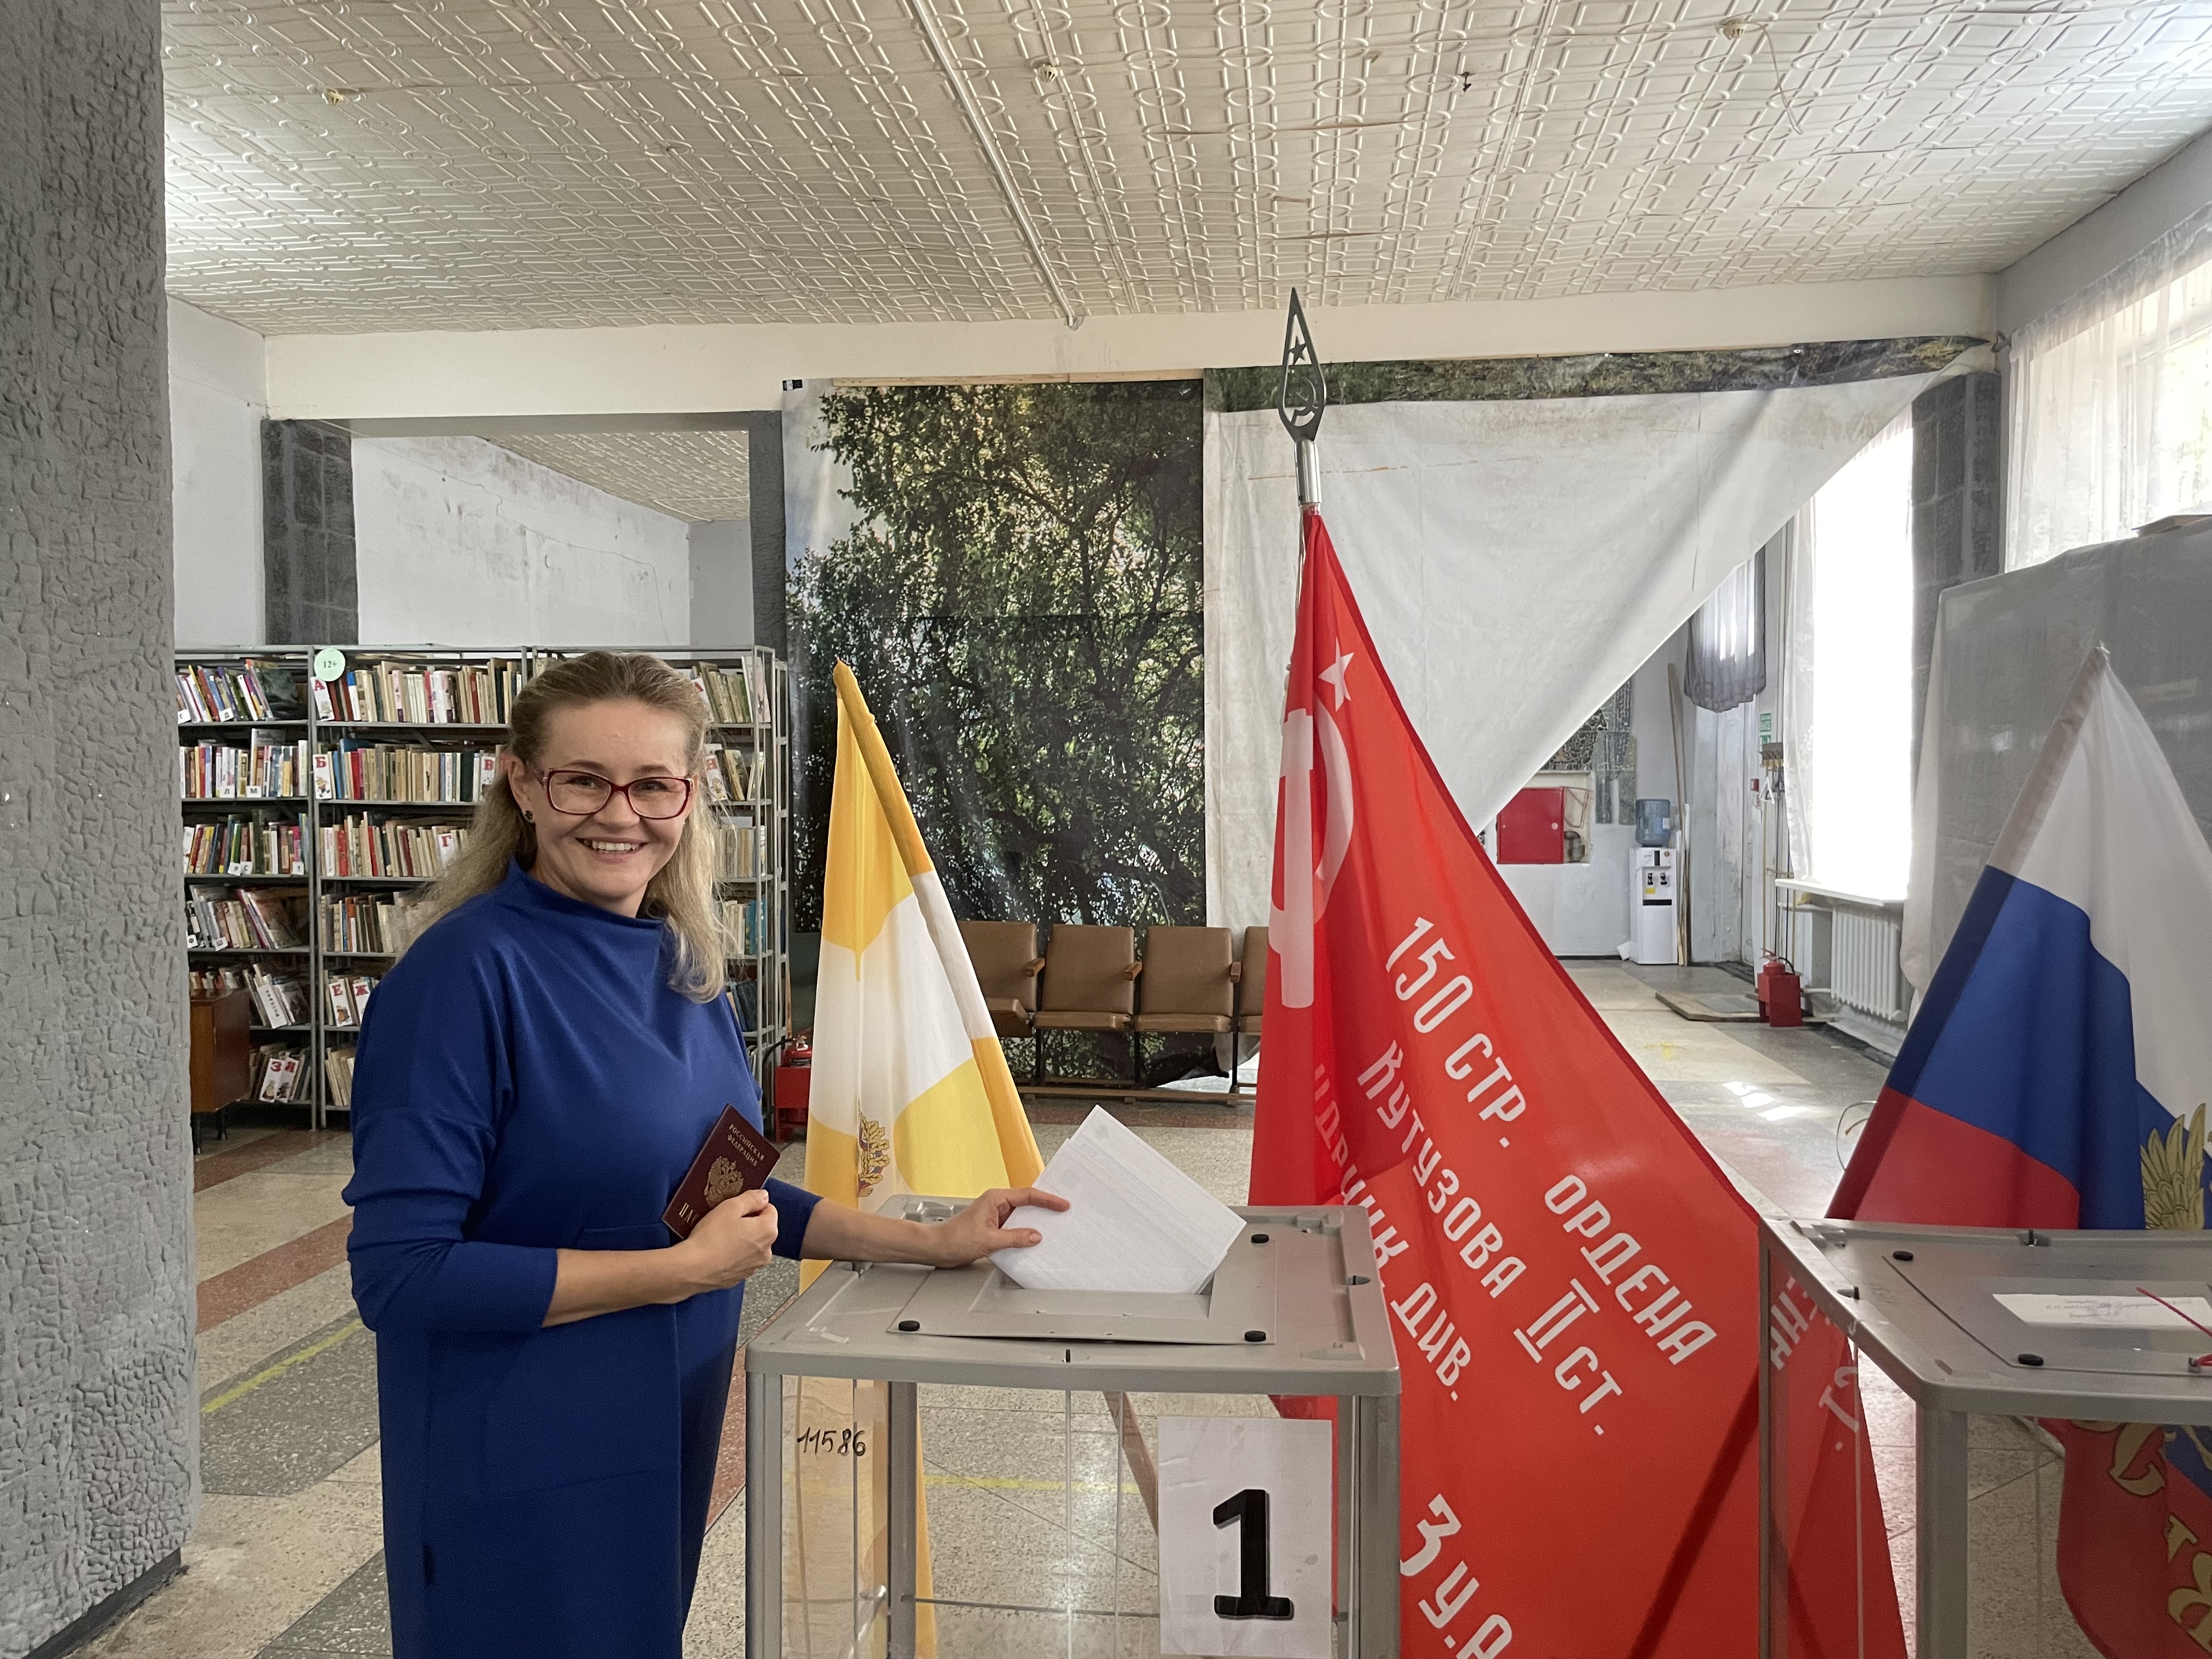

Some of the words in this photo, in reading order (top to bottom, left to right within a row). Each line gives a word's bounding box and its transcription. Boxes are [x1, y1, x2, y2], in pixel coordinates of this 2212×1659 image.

[314, 680, 325, 691] А
[315, 757, 326, 768] Б
[441, 835, 452, 847] Г
[331, 984, 343, 996] Е
[727, 1134, 758, 1167] ФЕДЕРАЦИЯ
[729, 1124, 765, 1161] РОССИЙСКАЯ
[1386, 917, 1473, 1034] 150
[1444, 1032, 1526, 1148] СТР.
[1544, 1175, 1718, 1365] ОРДЕНА
[1357, 1039, 1527, 1299] КУТУЗОВА
[1555, 1346, 1623, 1436] СТ.
[1390, 1282, 1471, 1401] ДИВ.
[797, 1426, 866, 1457] 11586
[1212, 1488, 1293, 1620] 1
